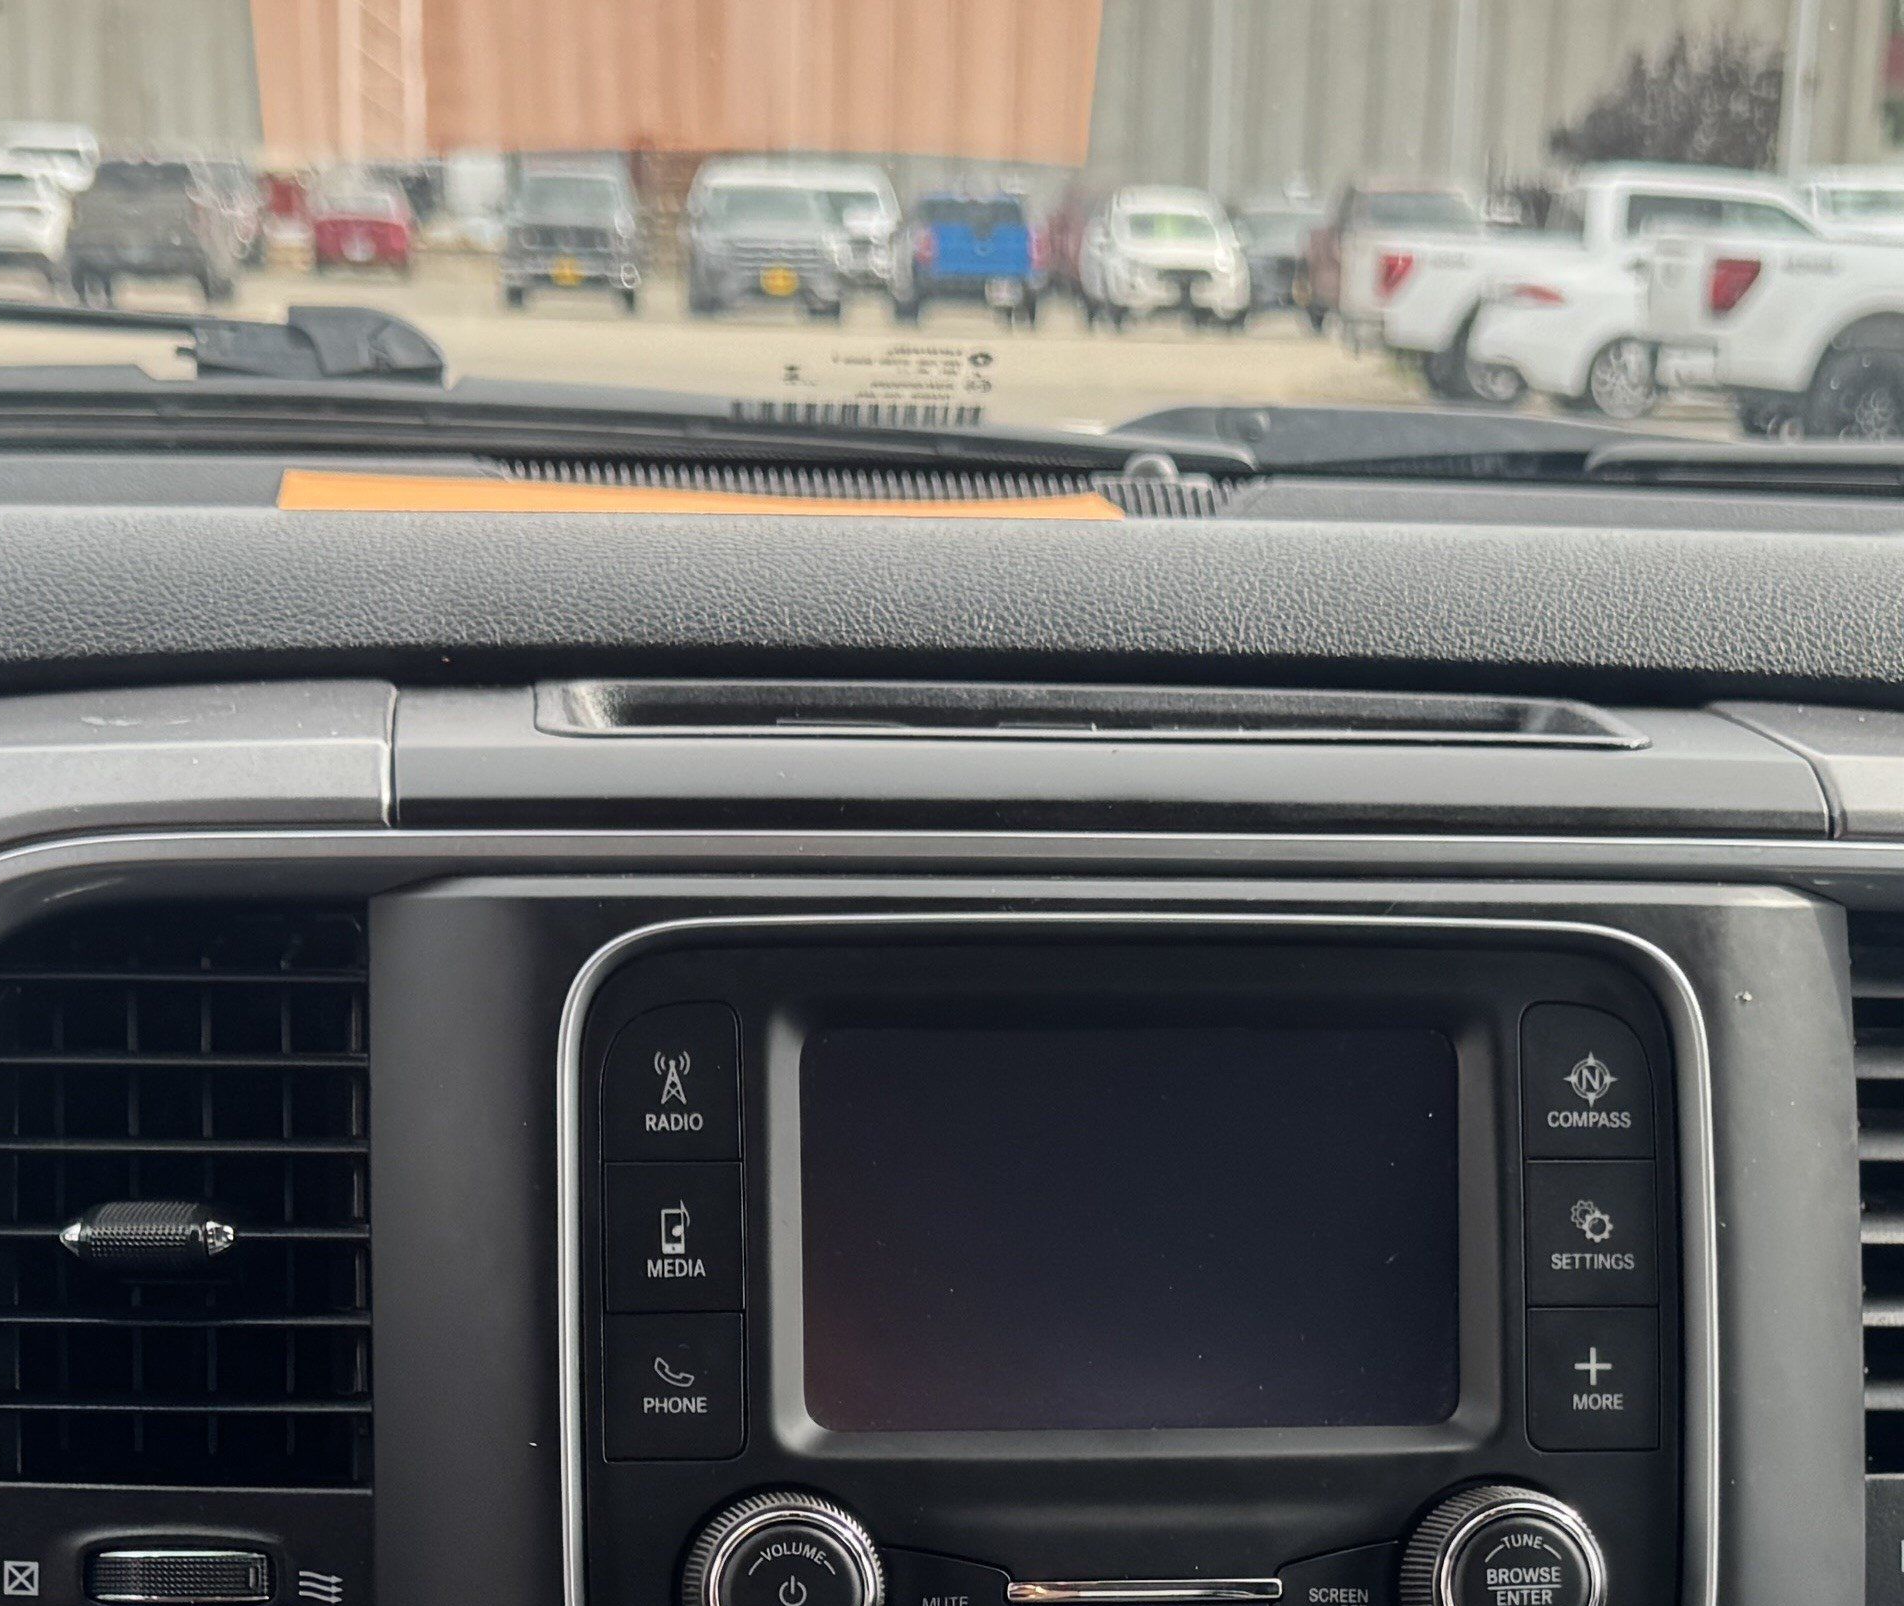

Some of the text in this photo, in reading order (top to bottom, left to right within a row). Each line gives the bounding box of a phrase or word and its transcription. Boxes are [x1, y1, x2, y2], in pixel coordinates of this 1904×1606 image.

[645, 1112, 704, 1132] RADIO
[1547, 1111, 1632, 1129] COMPASS
[647, 1258, 706, 1278] MEDIA
[1551, 1252, 1635, 1271] SETTINGS
[643, 1397, 708, 1414] PHONE
[1572, 1393, 1624, 1411] MORE
[1500, 1533, 1544, 1550] TUNE
[760, 1541, 827, 1565] VOLUME
[1486, 1566, 1562, 1585] BROWSE
[1308, 1588, 1369, 1603] SCREEN
[1496, 1589, 1553, 1606] ENTER
